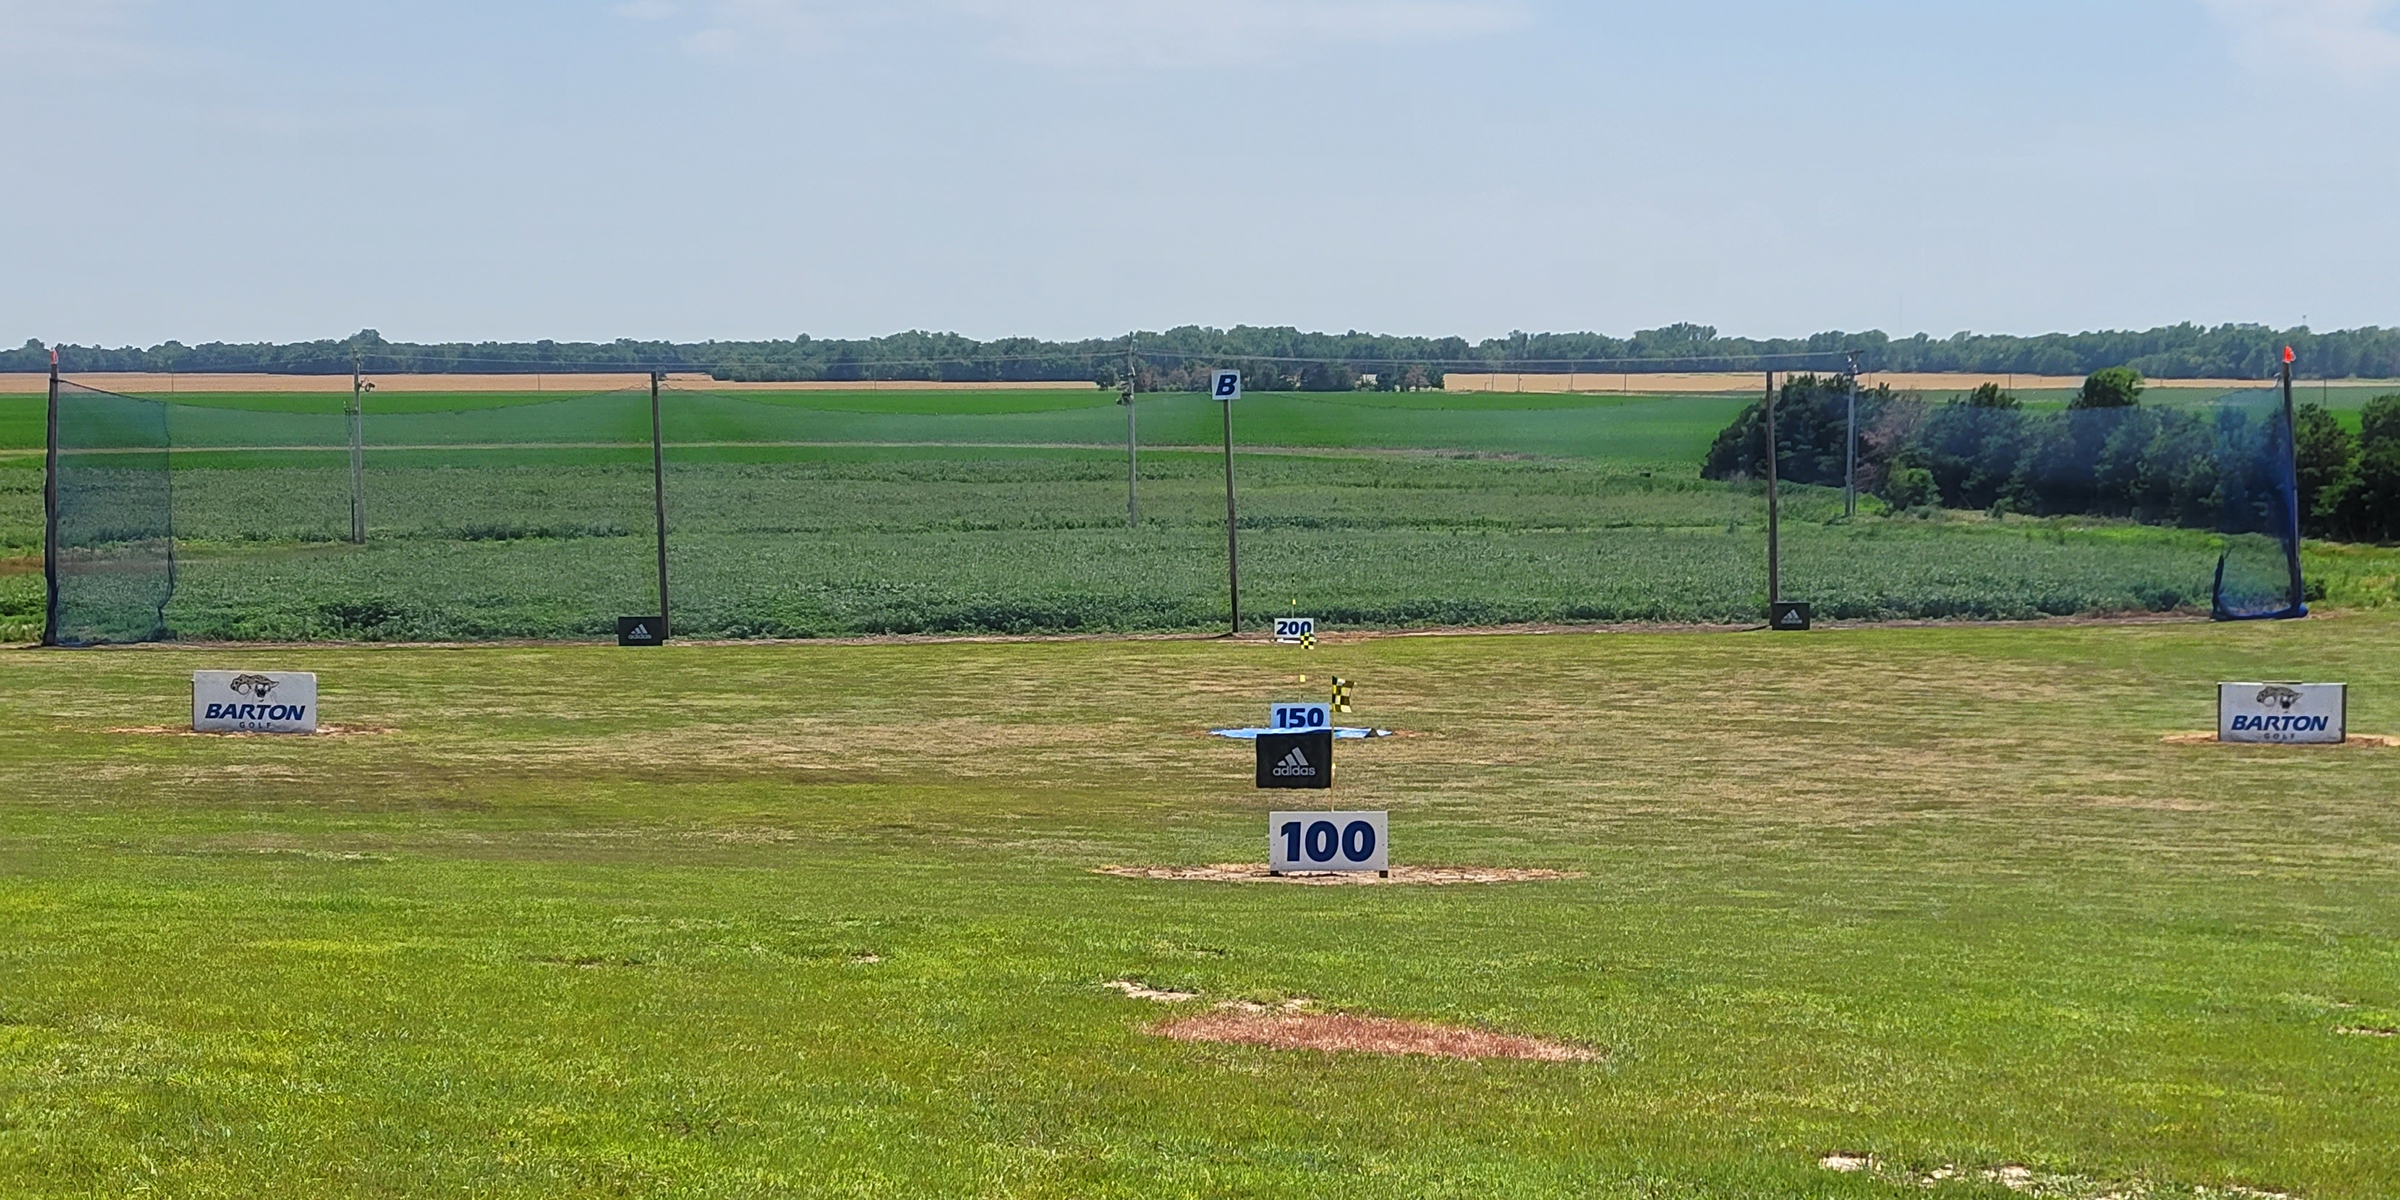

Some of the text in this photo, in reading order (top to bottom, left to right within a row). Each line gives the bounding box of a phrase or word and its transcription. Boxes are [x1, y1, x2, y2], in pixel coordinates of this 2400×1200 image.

[1215, 374, 1238, 396] B
[1276, 621, 1312, 636] 200
[205, 703, 306, 721] BARTON
[1276, 707, 1325, 728] 150
[239, 721, 272, 729] GOLF
[2231, 715, 2329, 731] BARTON
[2263, 732, 2296, 740] GOLF
[1272, 764, 1316, 776] adidas
[1280, 820, 1376, 862] 100
